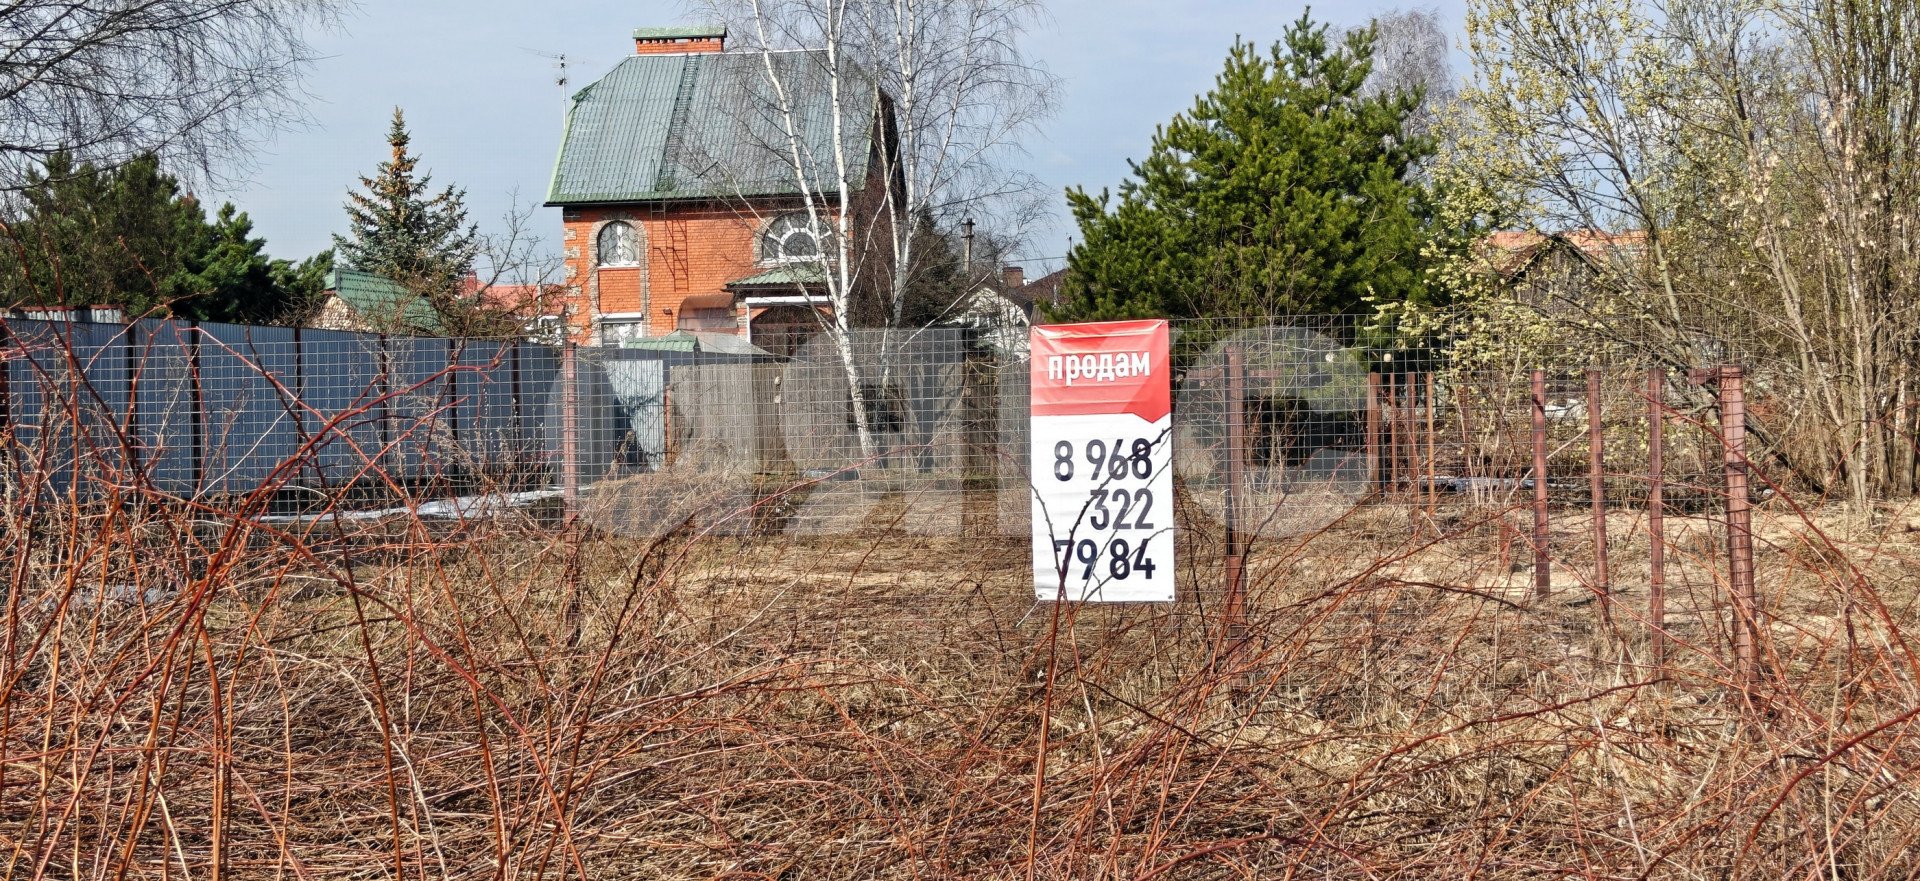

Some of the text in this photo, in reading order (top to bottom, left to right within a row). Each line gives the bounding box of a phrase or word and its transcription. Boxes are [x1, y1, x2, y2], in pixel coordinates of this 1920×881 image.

[1048, 351, 1151, 387] продам
[1053, 437, 1153, 482] 8 968
[1090, 488, 1154, 531] 322
[1054, 538, 1156, 581] 79 84
